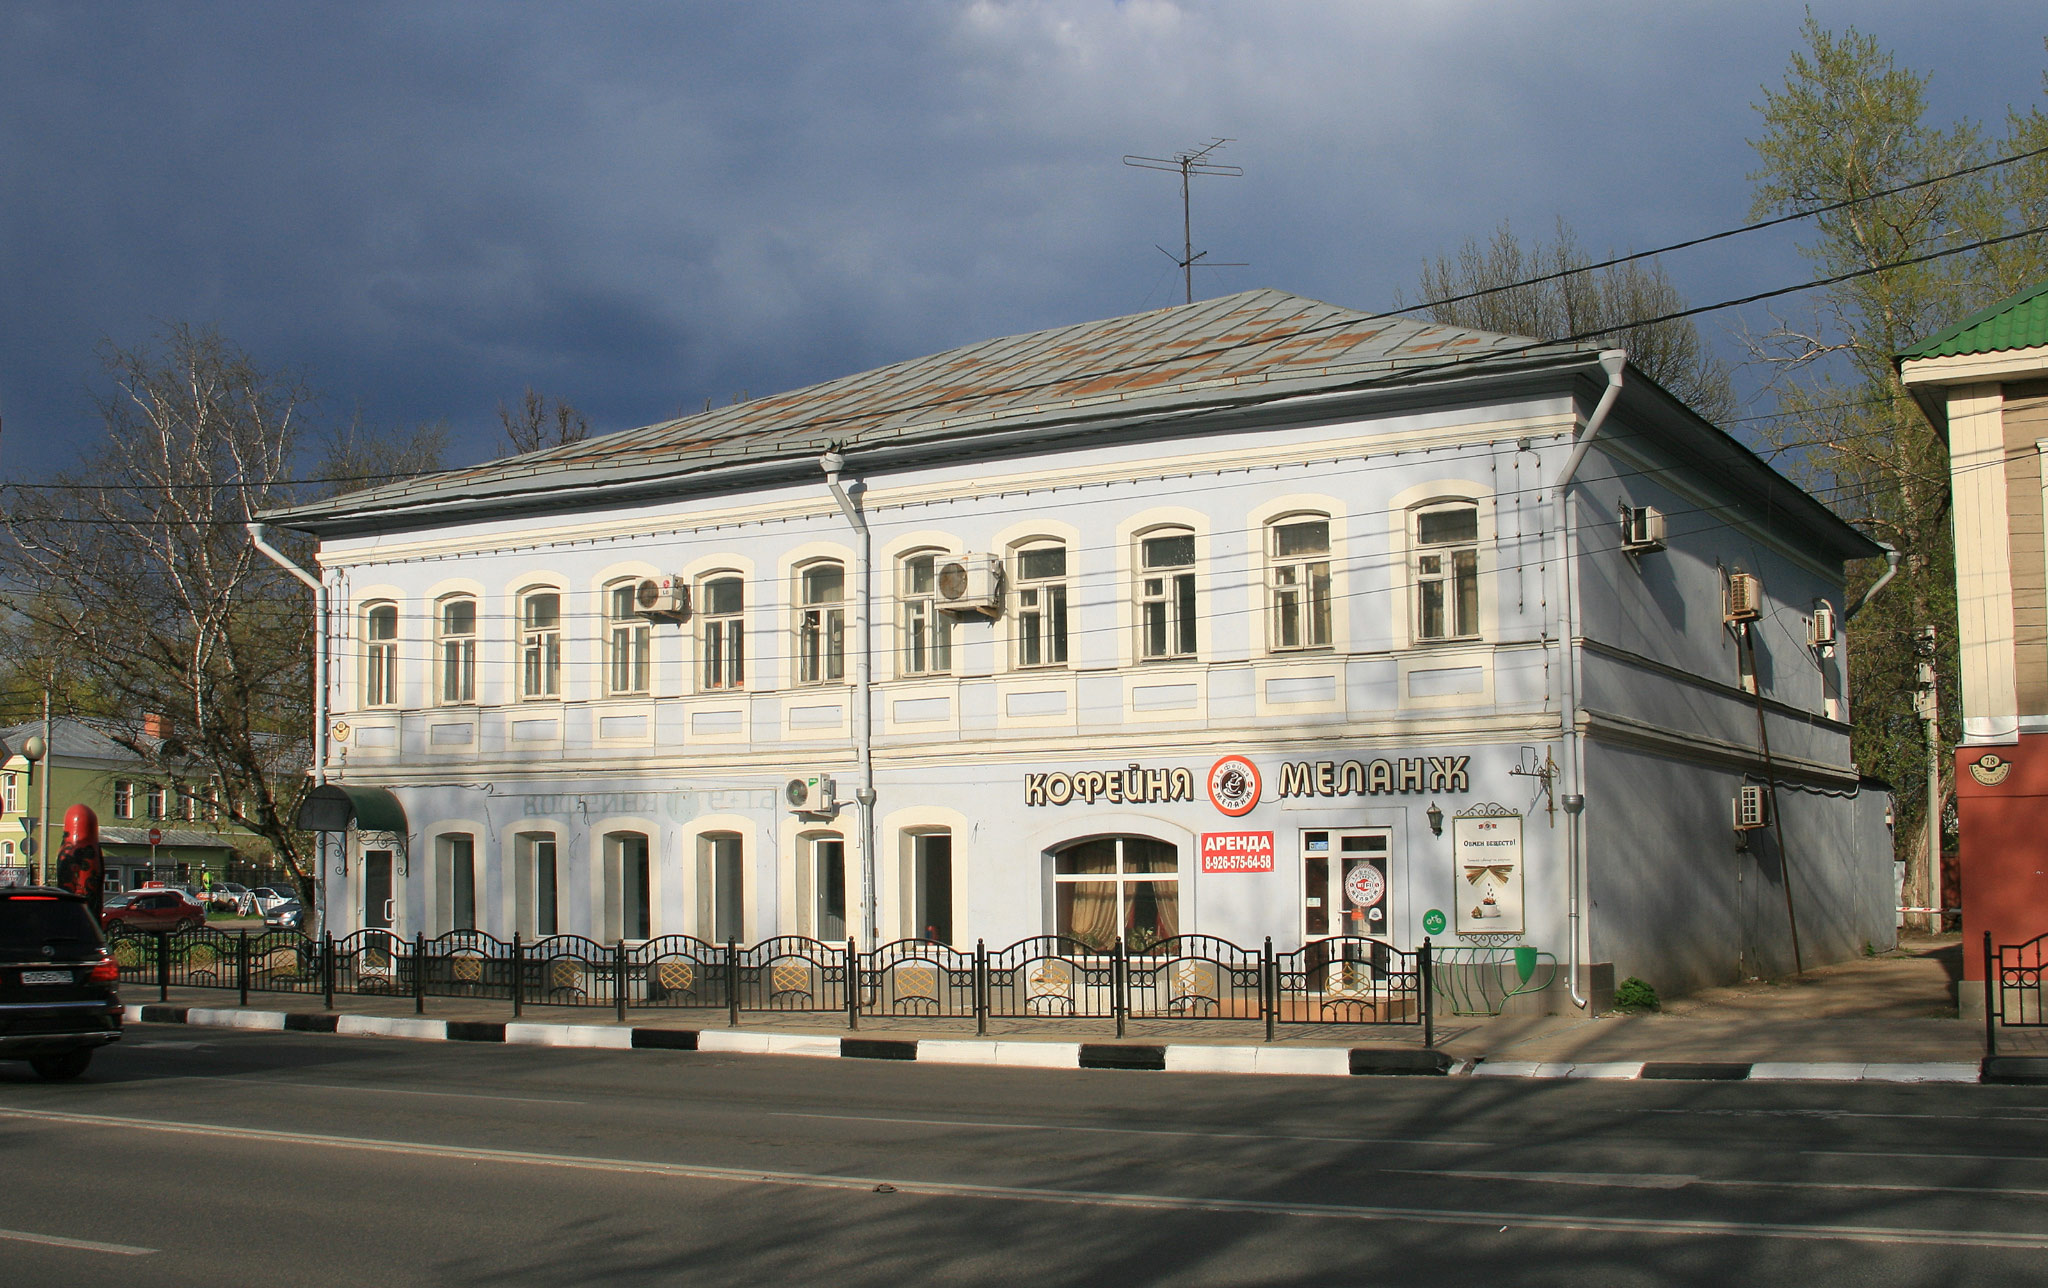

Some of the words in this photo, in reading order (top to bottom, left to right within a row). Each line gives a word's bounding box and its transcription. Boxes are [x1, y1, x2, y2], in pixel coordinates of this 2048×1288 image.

[1985, 757, 1996, 765] 78
[1024, 763, 1194, 807] КОФЕЙНЯ
[1278, 755, 1471, 798] МЕЛАНЖ
[1204, 835, 1271, 853] АРЕНДА
[1205, 855, 1271, 870] 8-926-575-64-58
